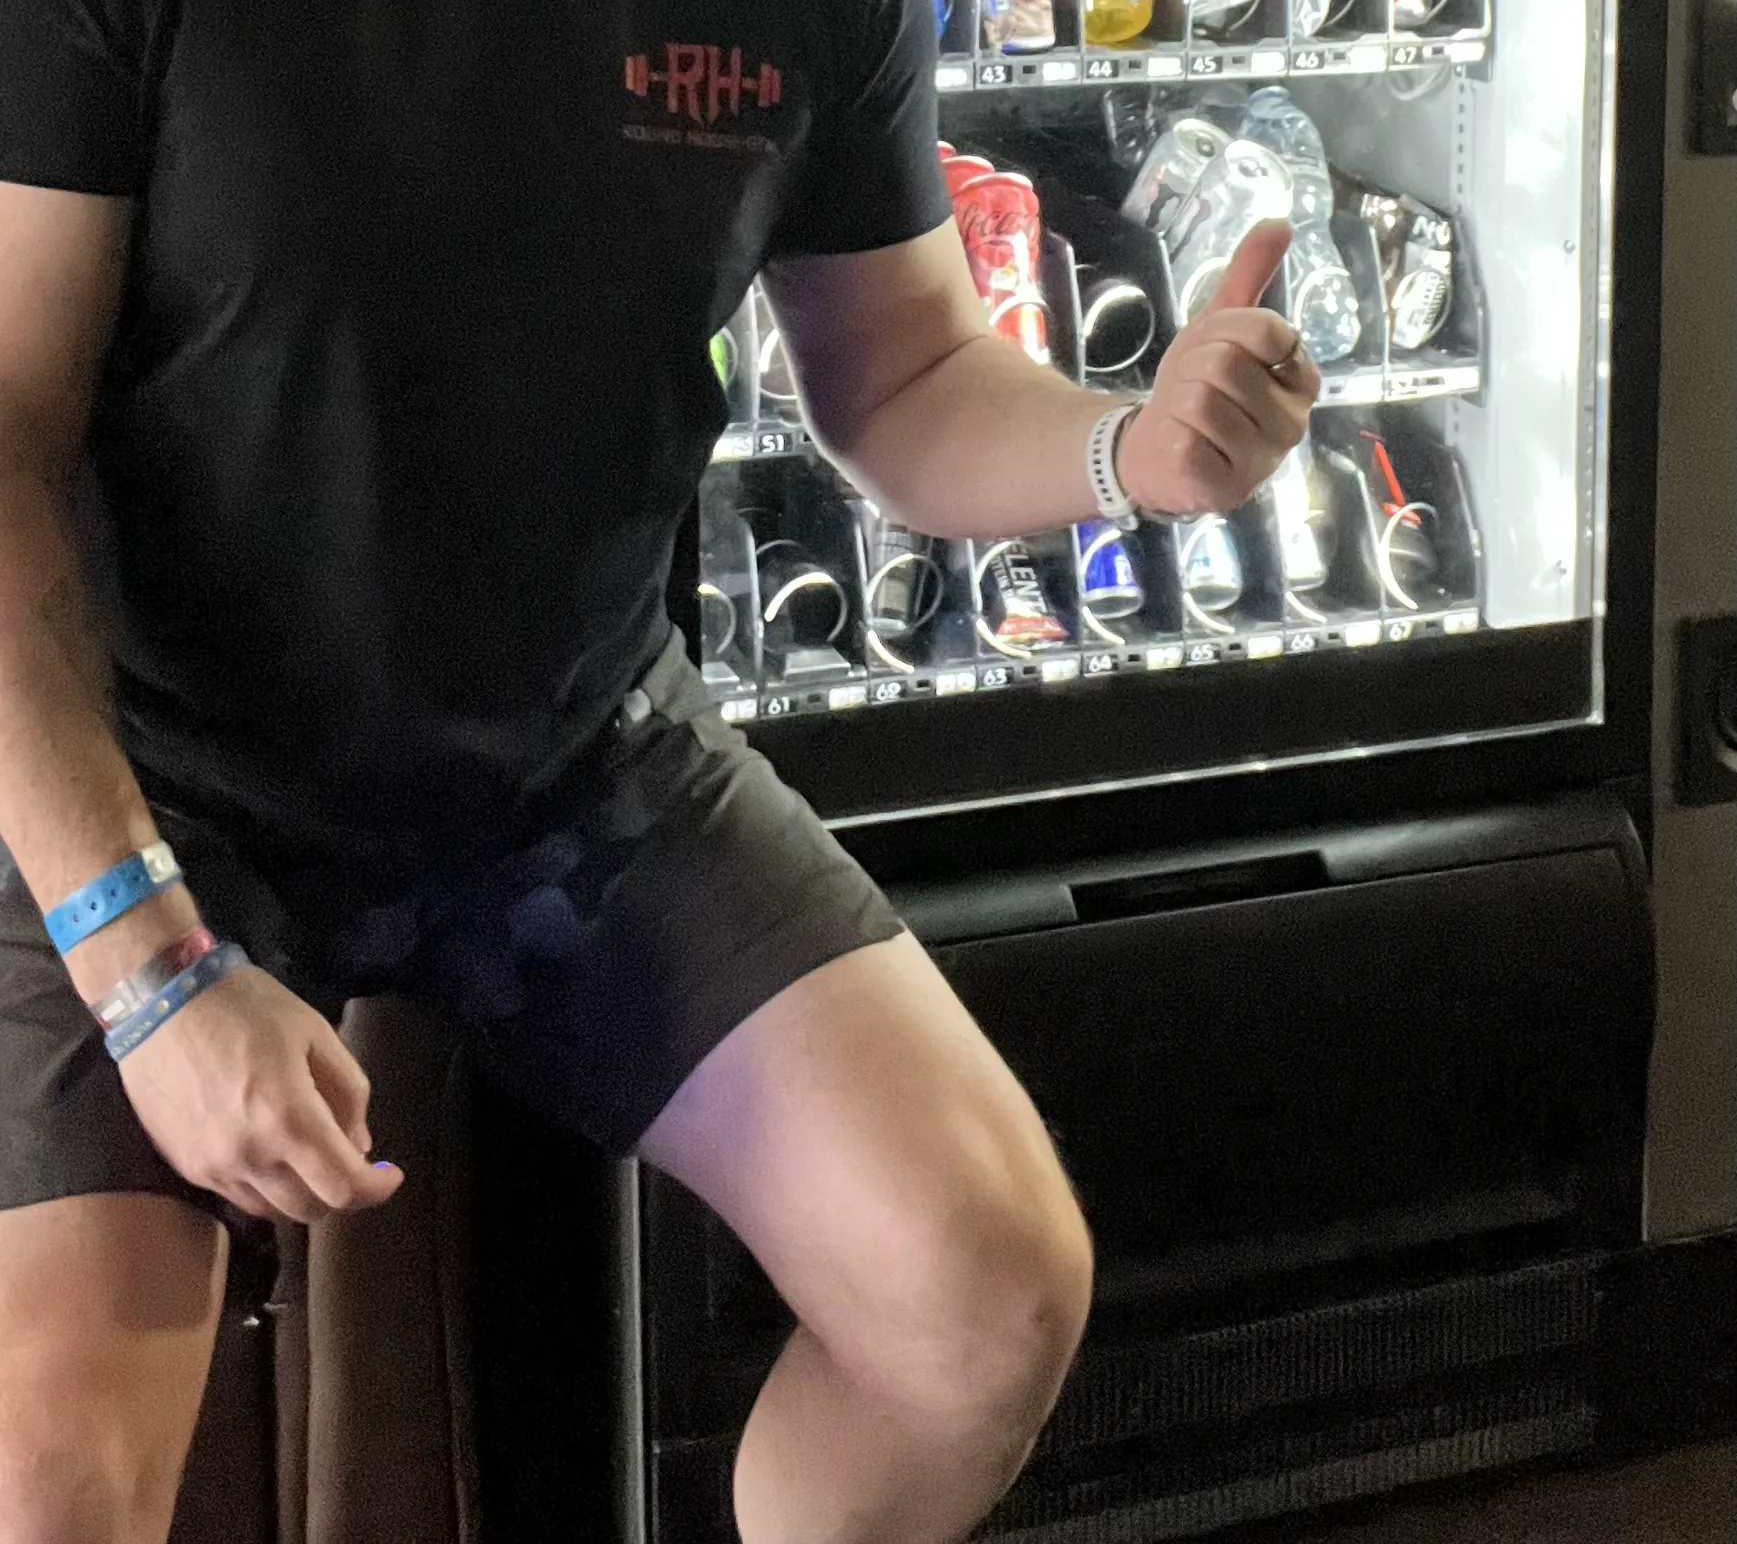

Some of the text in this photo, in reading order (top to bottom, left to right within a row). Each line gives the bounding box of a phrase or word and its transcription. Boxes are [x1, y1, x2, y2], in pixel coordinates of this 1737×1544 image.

[1296, 52, 1320, 69] 46
[1394, 46, 1417, 63] 47
[981, 65, 1006, 82] 43
[1088, 60, 1112, 78] 44
[1193, 56, 1217, 74] 45
[762, 434, 785, 453] 51
[1291, 633, 1315, 651] 66
[1190, 644, 1214, 661] 65
[1088, 655, 1113, 673] 64
[983, 668, 1008, 686] 63
[875, 682, 902, 701] 62
[767, 695, 790, 716] 61
